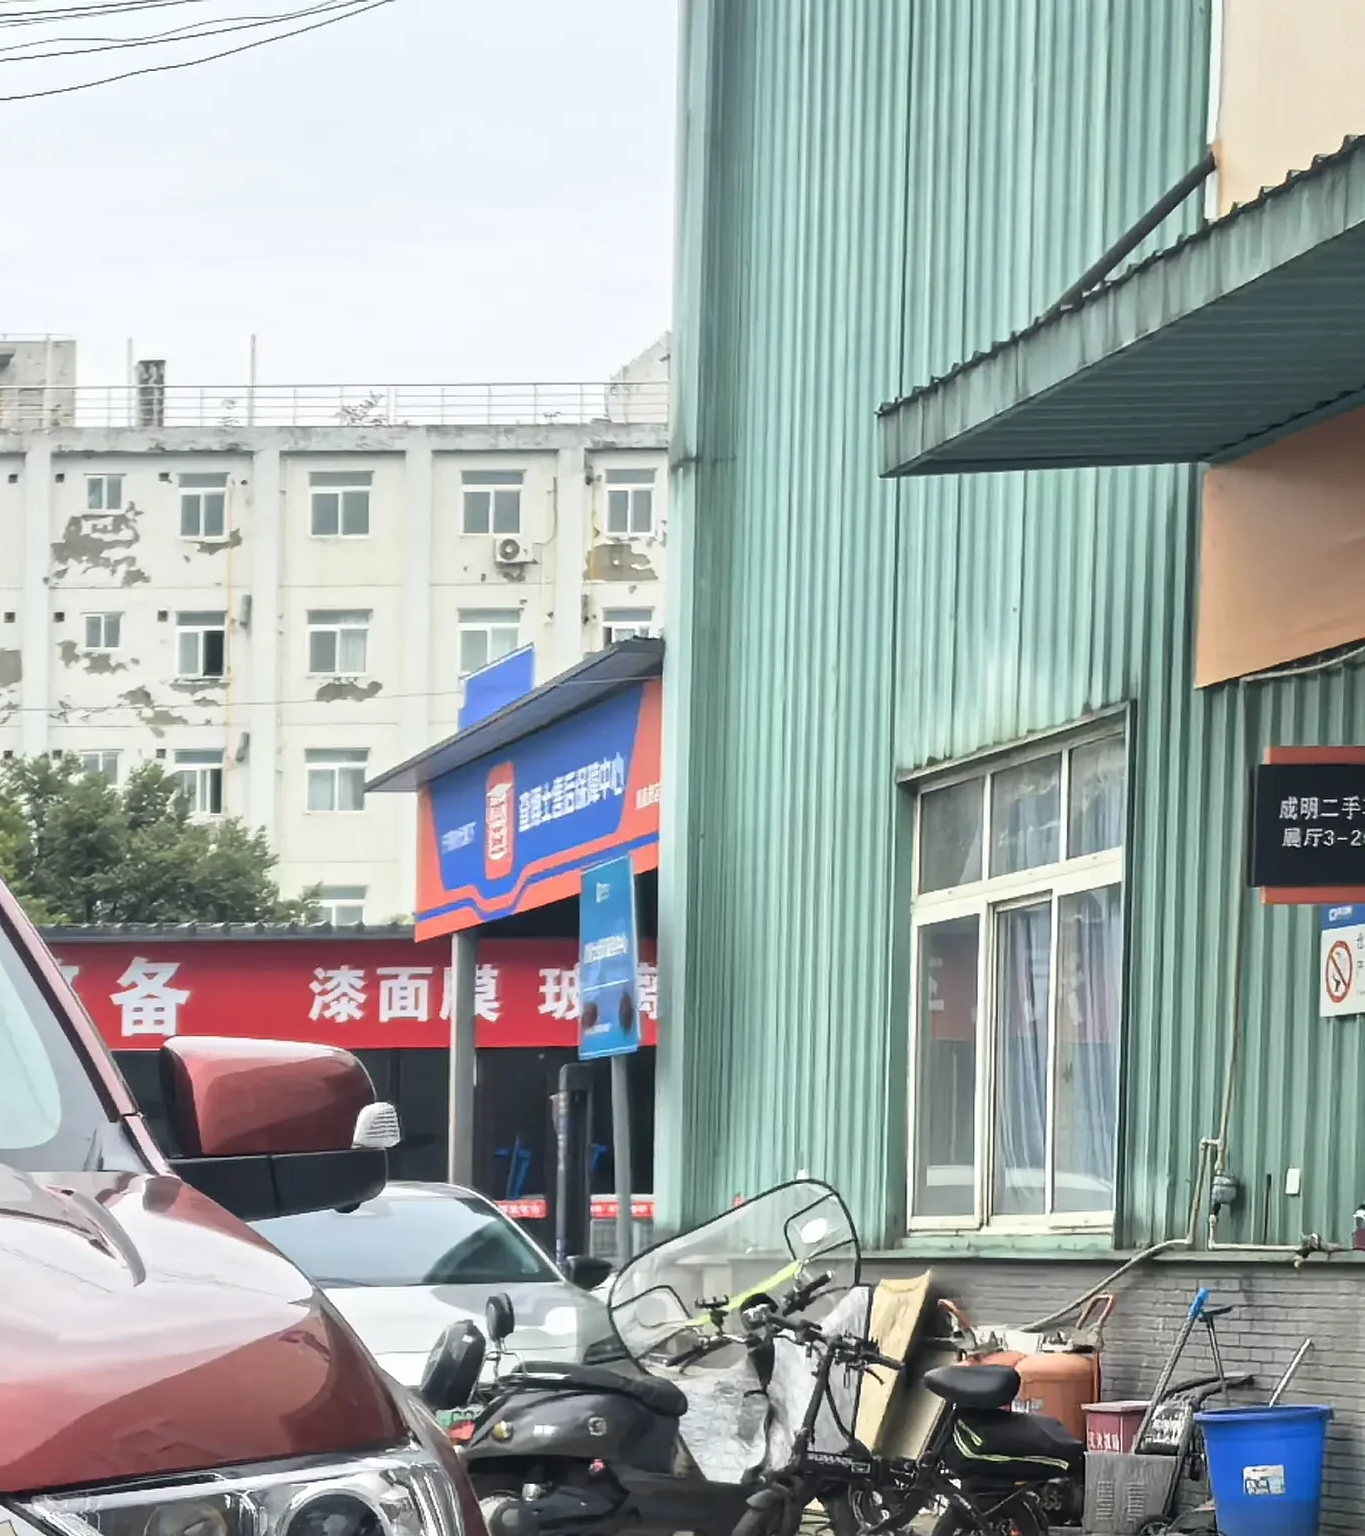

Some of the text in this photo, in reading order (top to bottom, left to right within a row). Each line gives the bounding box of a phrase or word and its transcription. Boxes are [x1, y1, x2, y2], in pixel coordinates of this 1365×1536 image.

[1279, 795, 1365, 820] 成明二手
[1282, 827, 1365, 848] 展厅3-2
[309, 964, 502, 1023] 漆面膜
